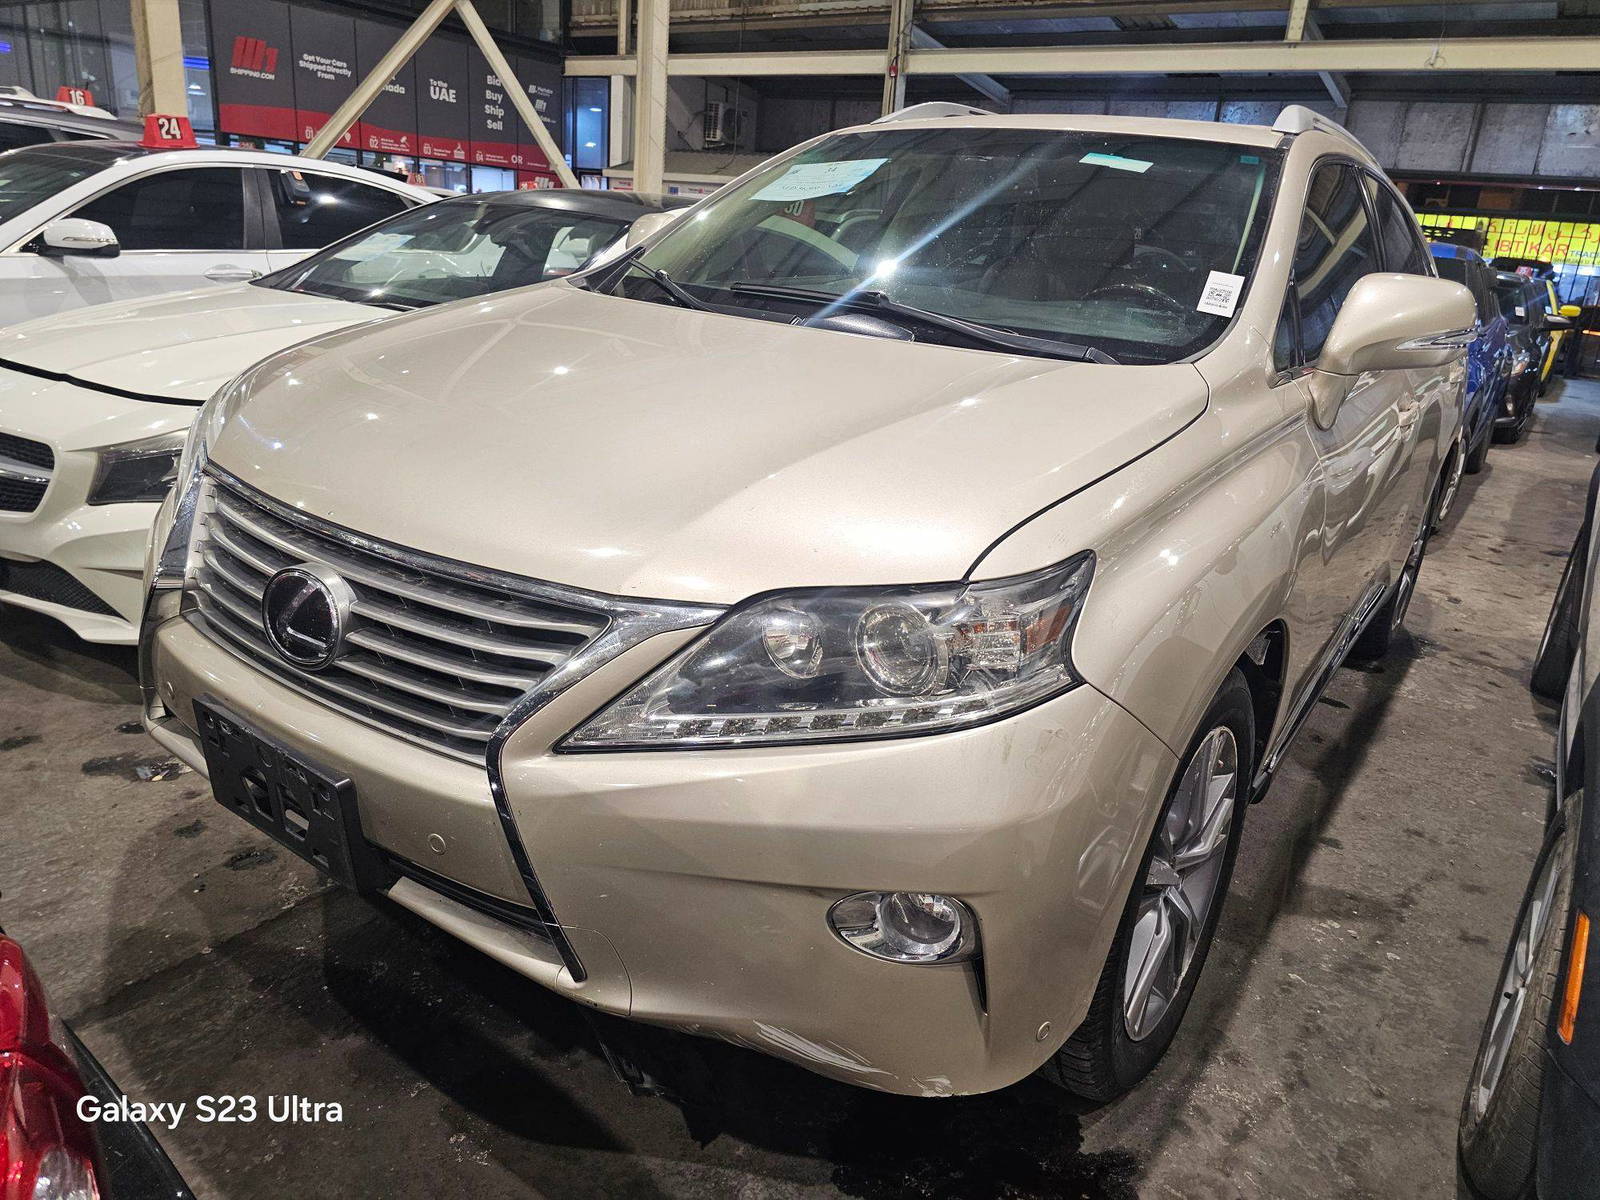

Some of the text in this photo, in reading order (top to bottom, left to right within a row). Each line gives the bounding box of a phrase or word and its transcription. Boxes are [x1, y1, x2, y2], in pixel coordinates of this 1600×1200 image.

[315, 55, 331, 64] Your
[317, 71, 335, 80] From
[69, 90, 85, 105] 16
[430, 86, 457, 103] UAE
[485, 90, 503, 104] Buy
[484, 105, 504, 119] Ship
[158, 118, 181, 139] 24
[486, 119, 503, 131] Sell
[511, 154, 523, 165] OR
